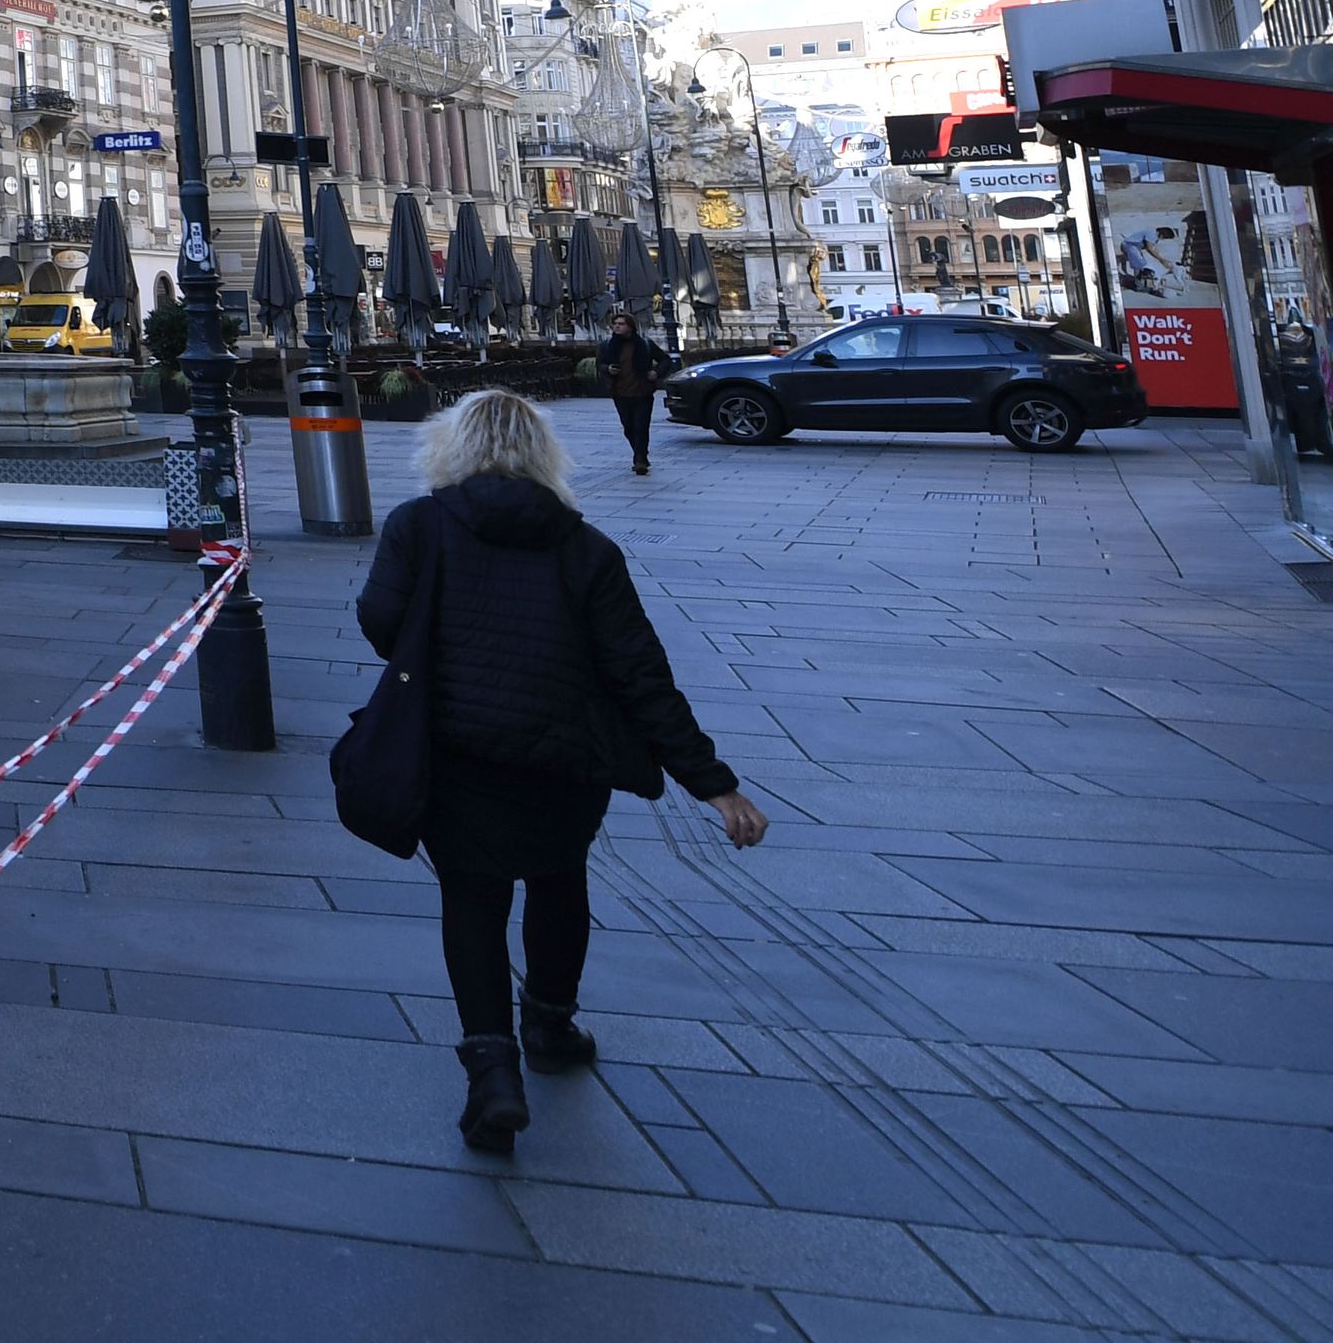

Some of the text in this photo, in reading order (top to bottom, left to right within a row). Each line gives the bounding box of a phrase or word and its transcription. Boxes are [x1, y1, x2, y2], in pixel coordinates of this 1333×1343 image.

[104, 134, 153, 148] Berlitz
[901, 143, 1012, 159] AM GRABEN
[970, 173, 1042, 187] swatch
[1133, 315, 1193, 331] Walk,
[1136, 331, 1193, 345] Don't
[1139, 346, 1186, 361] Run.
